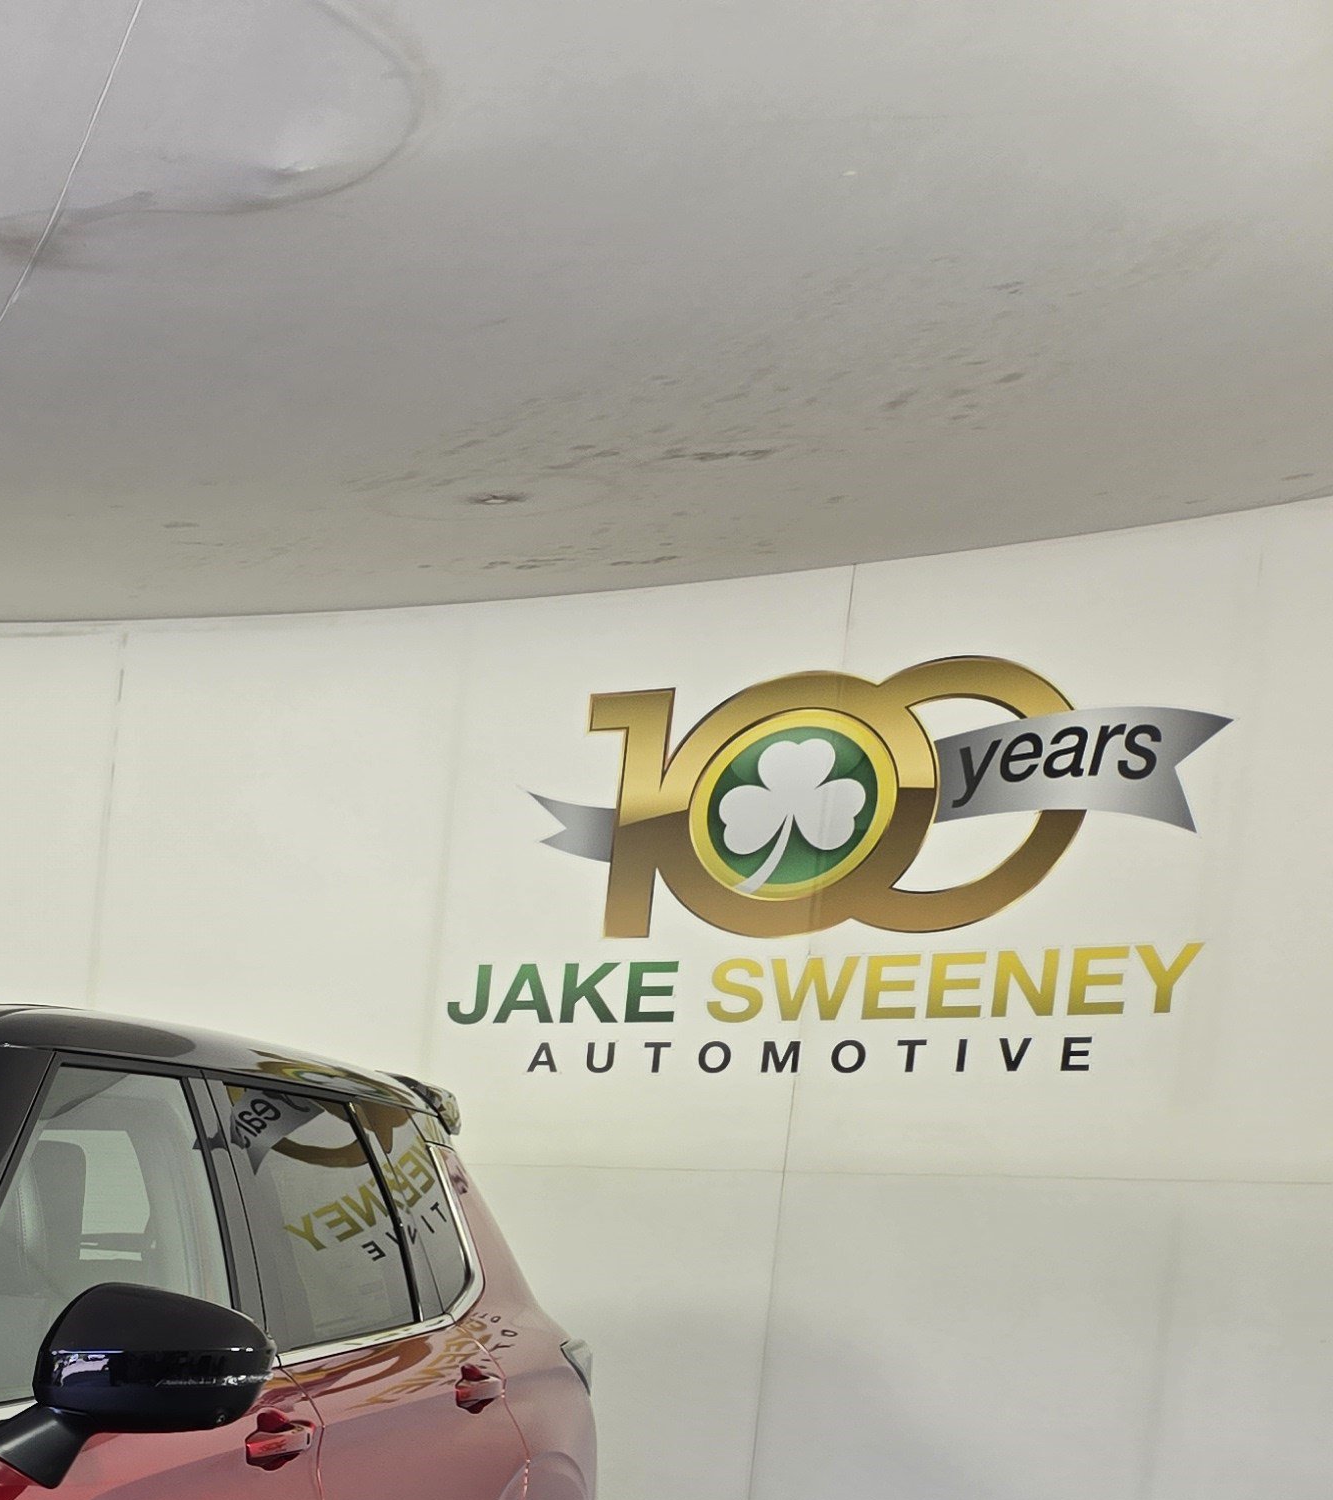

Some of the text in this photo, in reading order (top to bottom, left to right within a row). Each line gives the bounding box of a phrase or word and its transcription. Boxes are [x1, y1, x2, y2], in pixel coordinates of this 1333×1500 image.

[587, 655, 1164, 939] 100 years
[446, 942, 1206, 1026] JAKE SWEENEY
[526, 1036, 1093, 1075] AUTOMOTIVE
